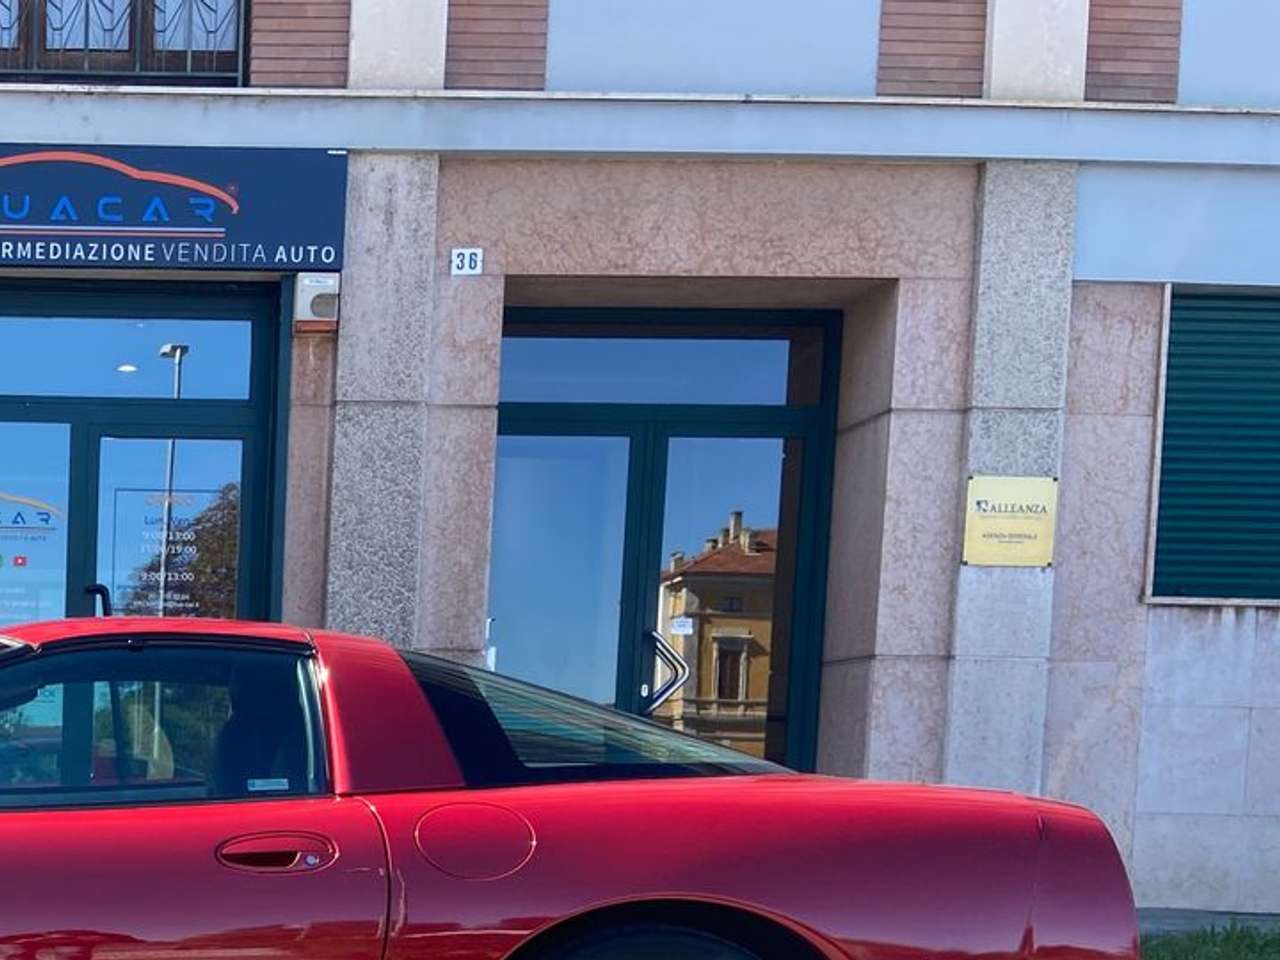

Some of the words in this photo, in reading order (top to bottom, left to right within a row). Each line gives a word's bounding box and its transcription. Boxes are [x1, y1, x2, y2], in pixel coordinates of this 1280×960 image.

[161, 242, 267, 263] VENDITA
[274, 245, 335, 263] AUTO
[456, 252, 478, 270] 36
[990, 503, 1048, 513] ALLEANZA
